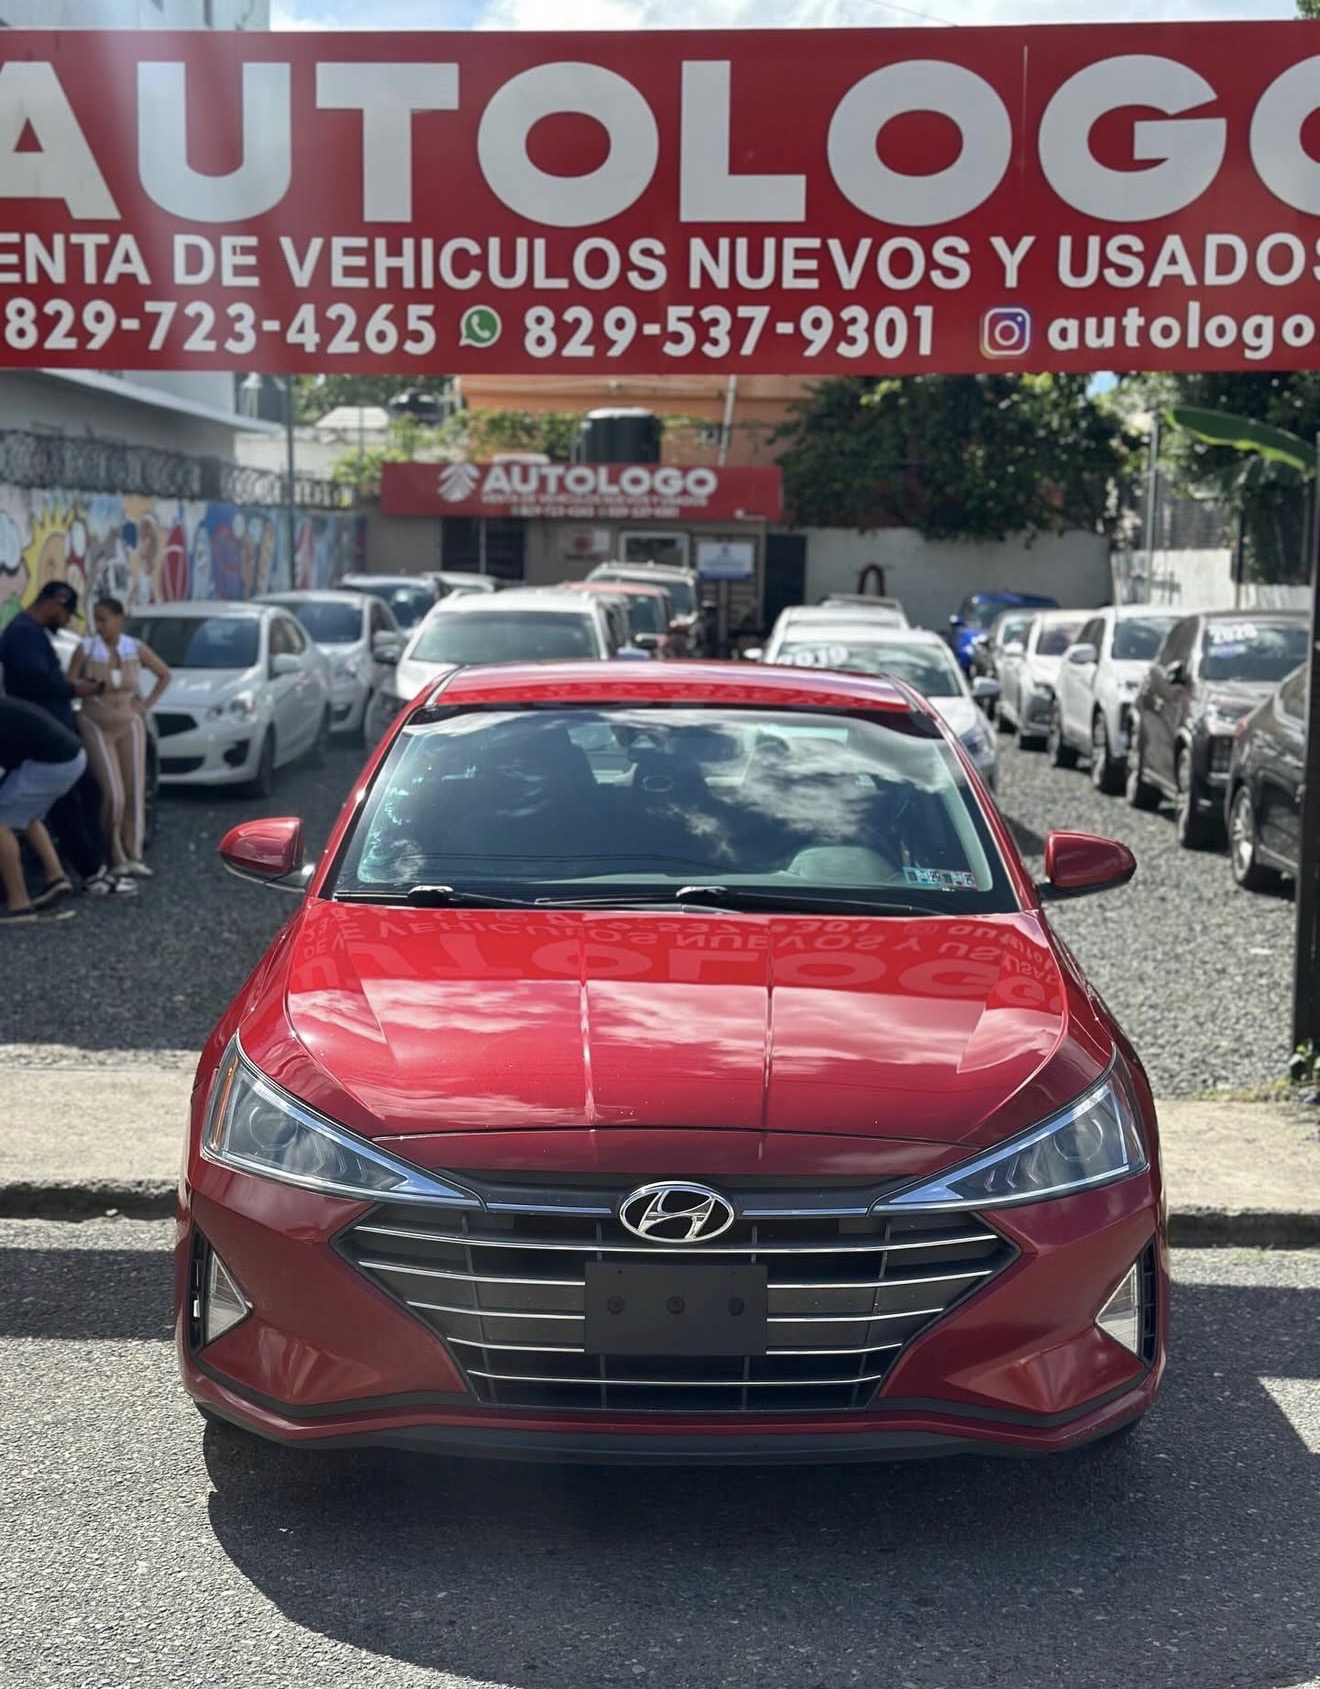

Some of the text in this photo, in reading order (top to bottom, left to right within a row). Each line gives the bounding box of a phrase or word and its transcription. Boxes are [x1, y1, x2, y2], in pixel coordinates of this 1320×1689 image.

[173, 234, 260, 287] DE
[280, 236, 667, 291] VEHICULOS
[689, 236, 971, 290] NUEVOS
[990, 236, 1035, 288] Y
[1058, 232, 1320, 288] USADO
[5, 298, 1316, 360] 829-723-4265 829-537-9301 autologo
[481, 464, 718, 497] AUTOLOGO
